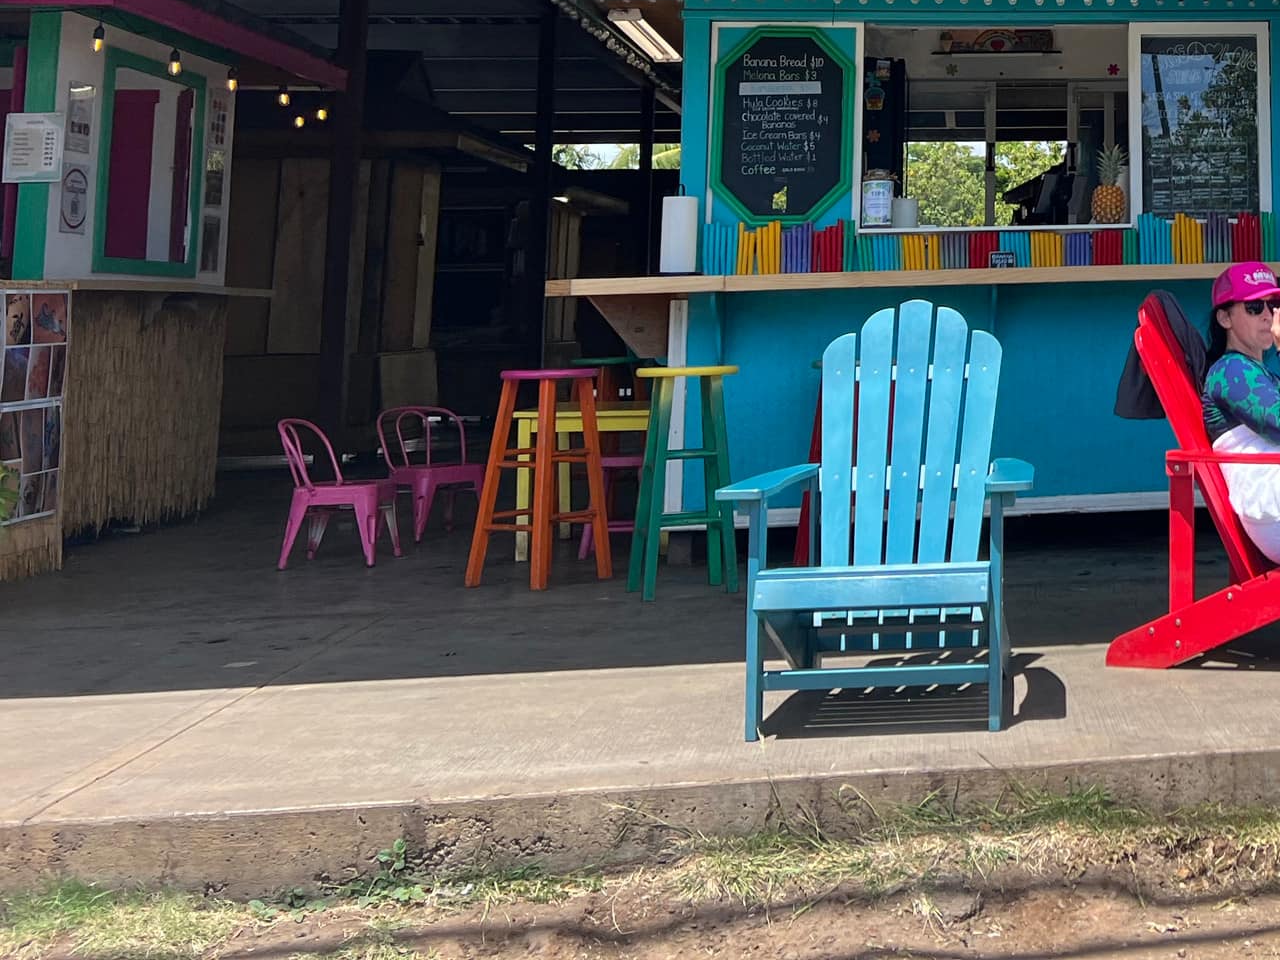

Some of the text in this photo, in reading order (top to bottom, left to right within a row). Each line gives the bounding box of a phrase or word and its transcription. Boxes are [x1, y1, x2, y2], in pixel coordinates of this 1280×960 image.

[743, 52, 825, 69] Banana Bread $10
[779, 69, 801, 81] Bars
[765, 95, 804, 108] Cookies
[761, 120, 797, 130] Bananas
[742, 129, 758, 140] Ice
[760, 129, 787, 140] Cream
[787, 130, 808, 140] Bars
[740, 141, 774, 152] Coconut
[776, 141, 802, 151] Water
[740, 164, 777, 176] Coffee
